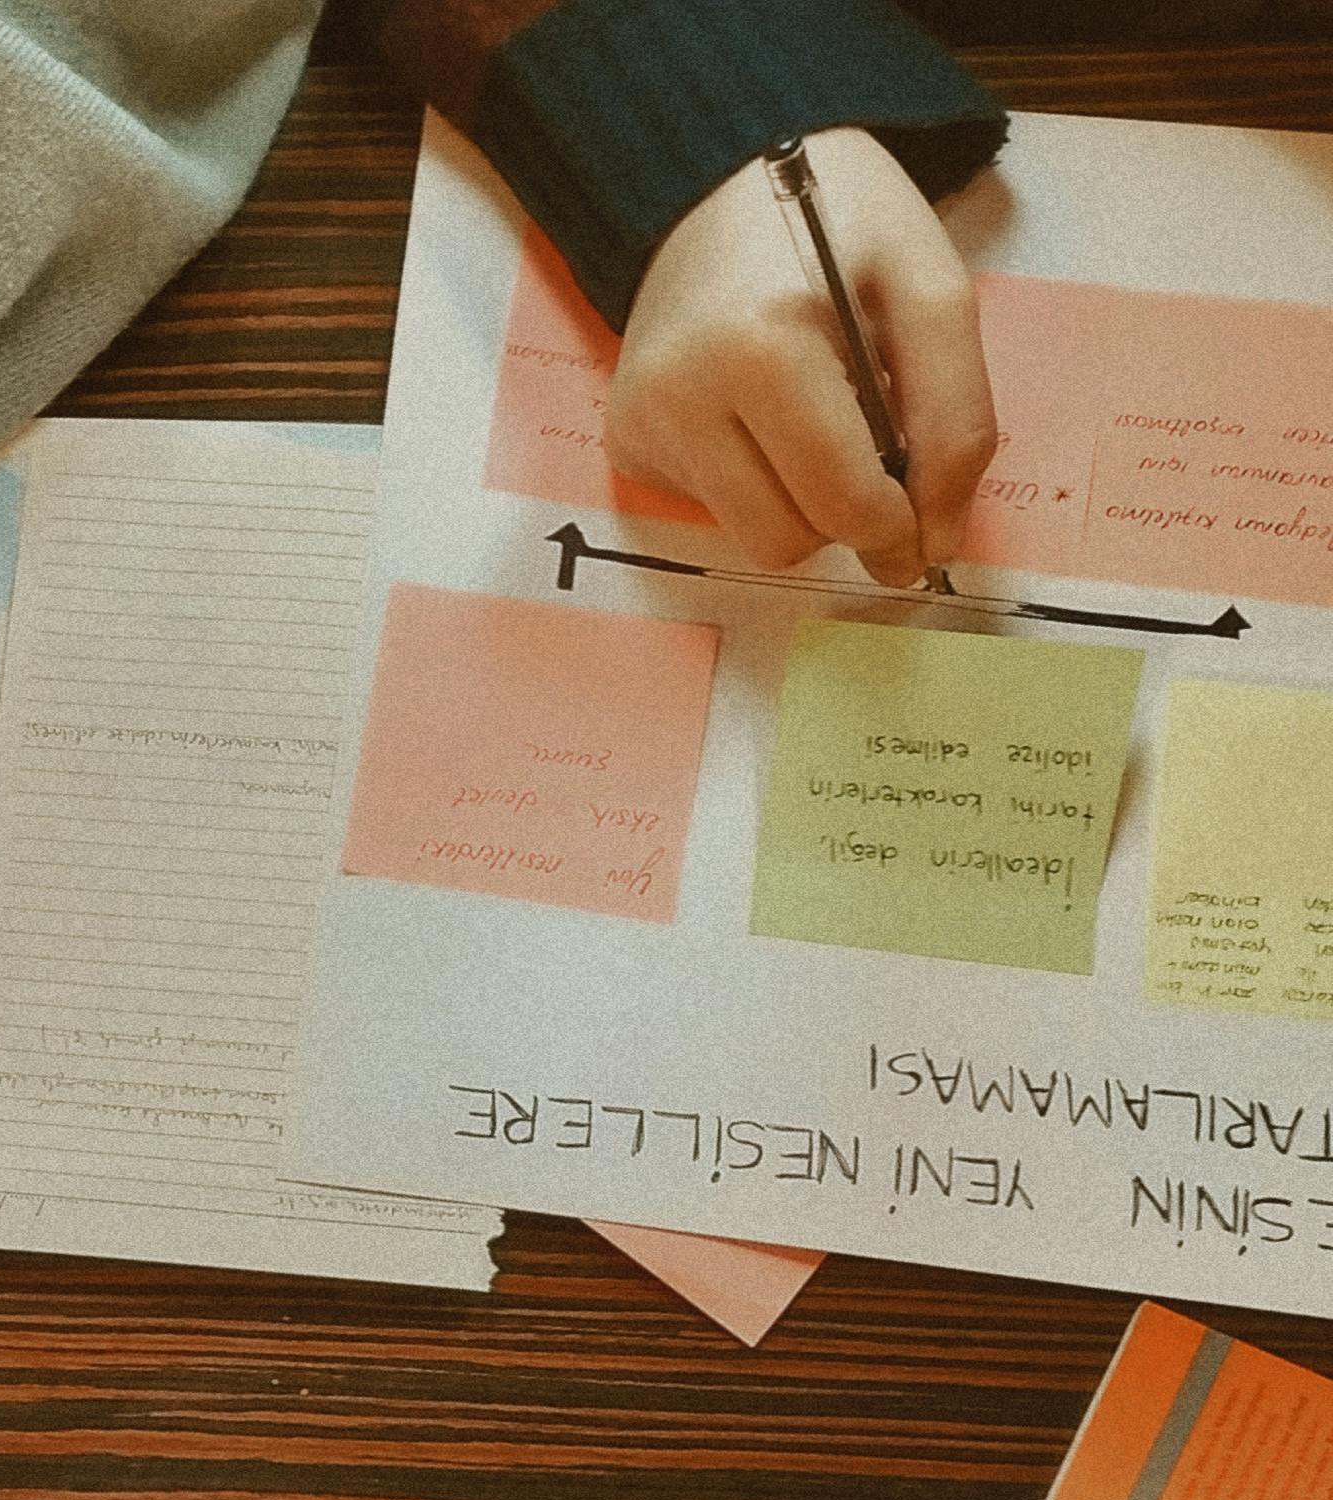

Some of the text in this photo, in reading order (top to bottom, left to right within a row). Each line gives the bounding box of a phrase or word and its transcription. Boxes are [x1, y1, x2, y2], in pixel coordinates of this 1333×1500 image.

[976, 476, 1039, 511] Ülkü
[864, 730, 1092, 777] idolize edilmesi
[807, 774, 1094, 831] tarihi karakterlerin
[924, 839, 1074, 912] İdeallerin
[861, 1041, 1333, 1162] TARILAMAMASI
[440, 1081, 863, 1199] NESİLLERE
[885, 1145, 1039, 1229] YENİ
